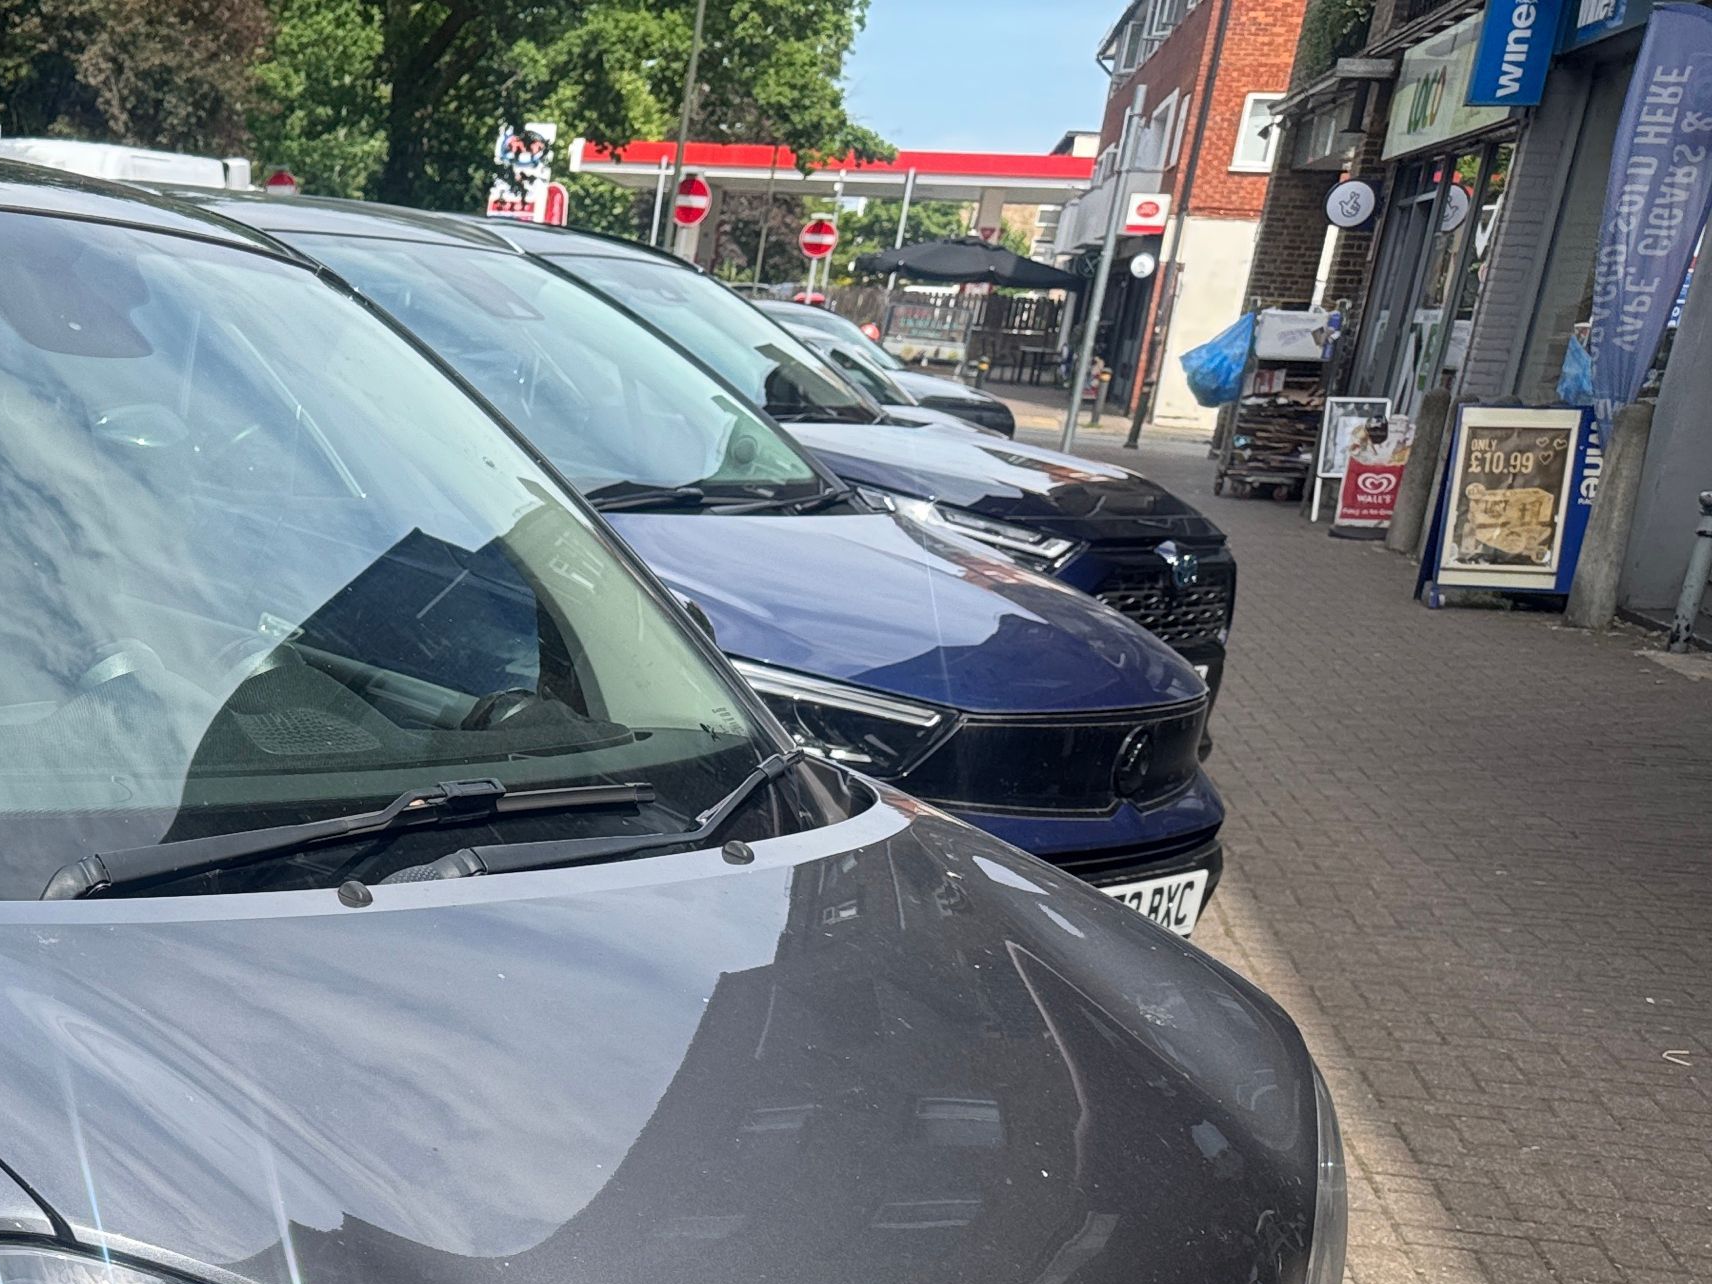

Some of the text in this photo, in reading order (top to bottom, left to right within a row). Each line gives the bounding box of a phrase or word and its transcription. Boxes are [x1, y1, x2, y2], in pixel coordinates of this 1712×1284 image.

[1495, 4, 1537, 98] wine
[1471, 438, 1497, 451] ONLY
[1468, 451, 1534, 474] £10.99
